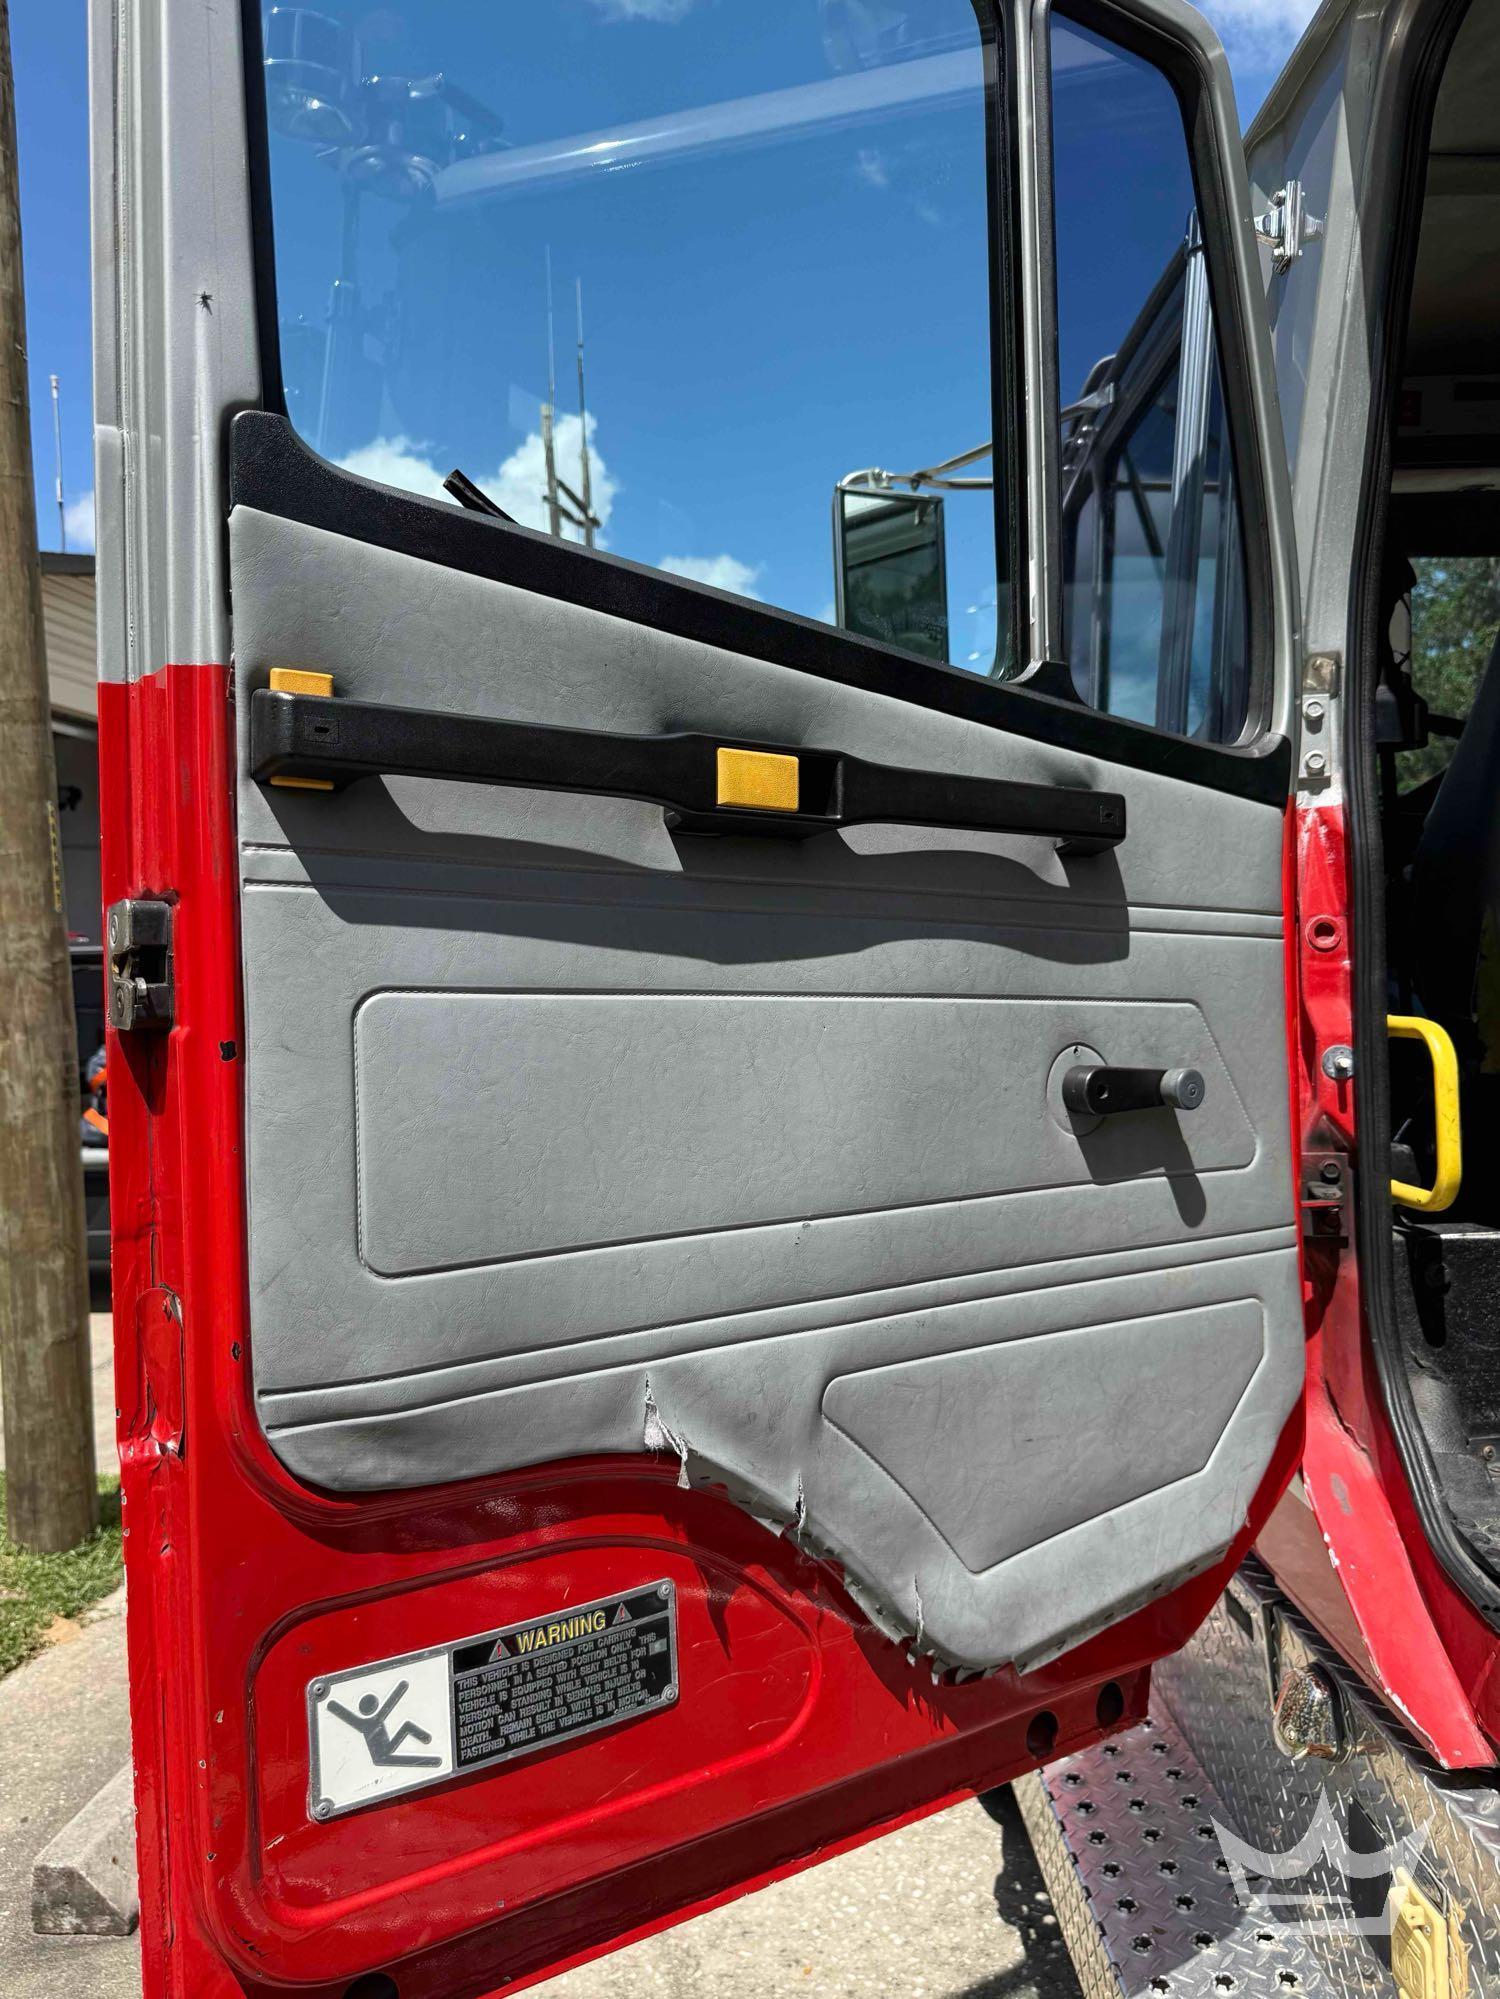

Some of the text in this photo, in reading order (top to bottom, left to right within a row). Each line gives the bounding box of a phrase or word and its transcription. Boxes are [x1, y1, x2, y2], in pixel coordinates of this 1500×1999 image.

[458, 1628, 637, 1691] THIS VEHICLE IS DESIGNED FOR CARRYING
[516, 1609, 606, 1653] WARNING
[459, 1632, 656, 1702] PERSONNEL IN A SEATED POSITION ONLY. THIS
[459, 1647, 647, 1713] VEHICLE IS EQUIPPED WITH SEAT BELTS FOR
[459, 1659, 640, 1726] PERSONS. STANDING WHILE VEHICLE IS IN
[459, 1669, 646, 1737] MOTION CAN RESULT IN SERIOUS INJURY OR
[460, 1681, 641, 1749] DEATH. REMAIN SEATED WITH SEAT BELTS
[461, 1738, 505, 1760] FASTENED
[508, 1728, 536, 1744] WHILE
[539, 1721, 556, 1735] THE
[560, 1708, 593, 1728] VEHICLE
[596, 1705, 604, 1716] IS
[607, 1701, 616, 1711] IN
[618, 1689, 650, 1707] MOTION.
